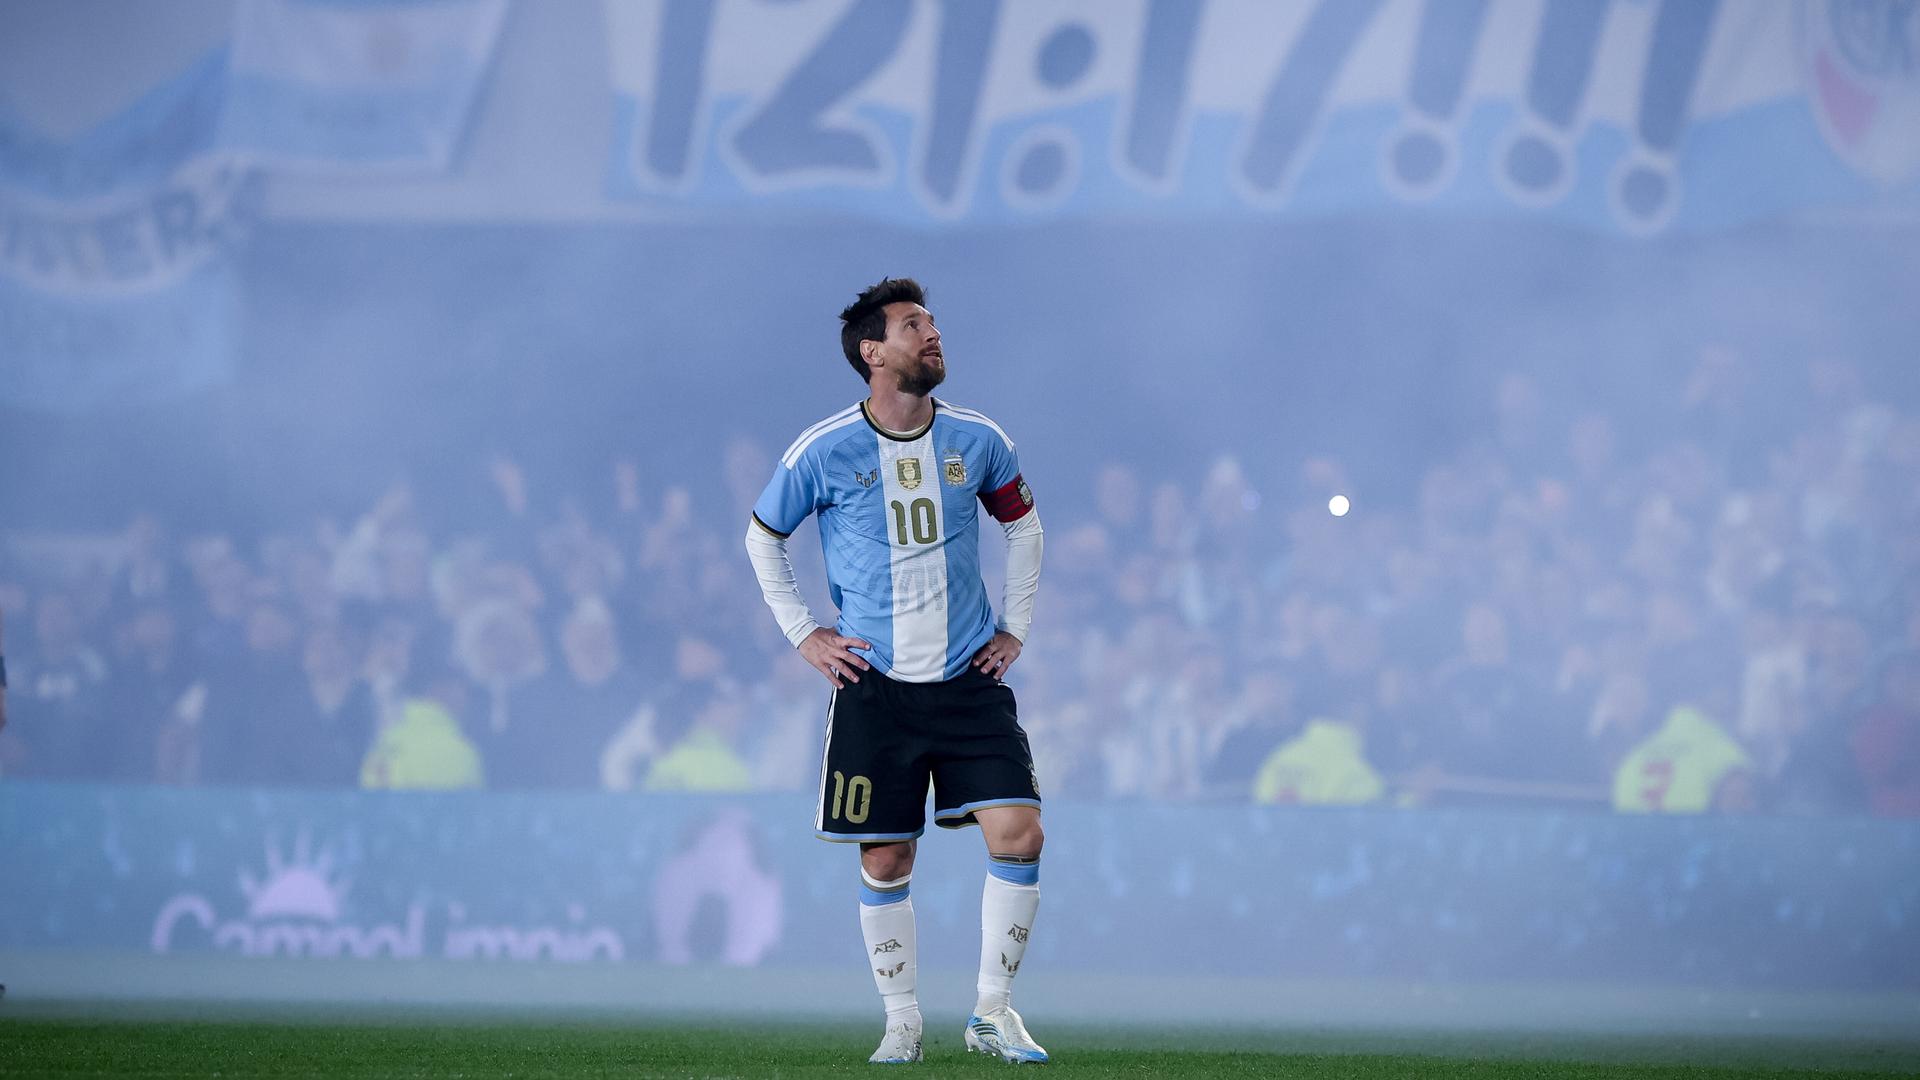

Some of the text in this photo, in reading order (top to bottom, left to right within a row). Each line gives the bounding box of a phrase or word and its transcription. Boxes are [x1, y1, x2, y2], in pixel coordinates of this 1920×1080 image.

[890, 498, 938, 545] 10
[831, 771, 872, 825] 10
[873, 938, 902, 955] AFA
